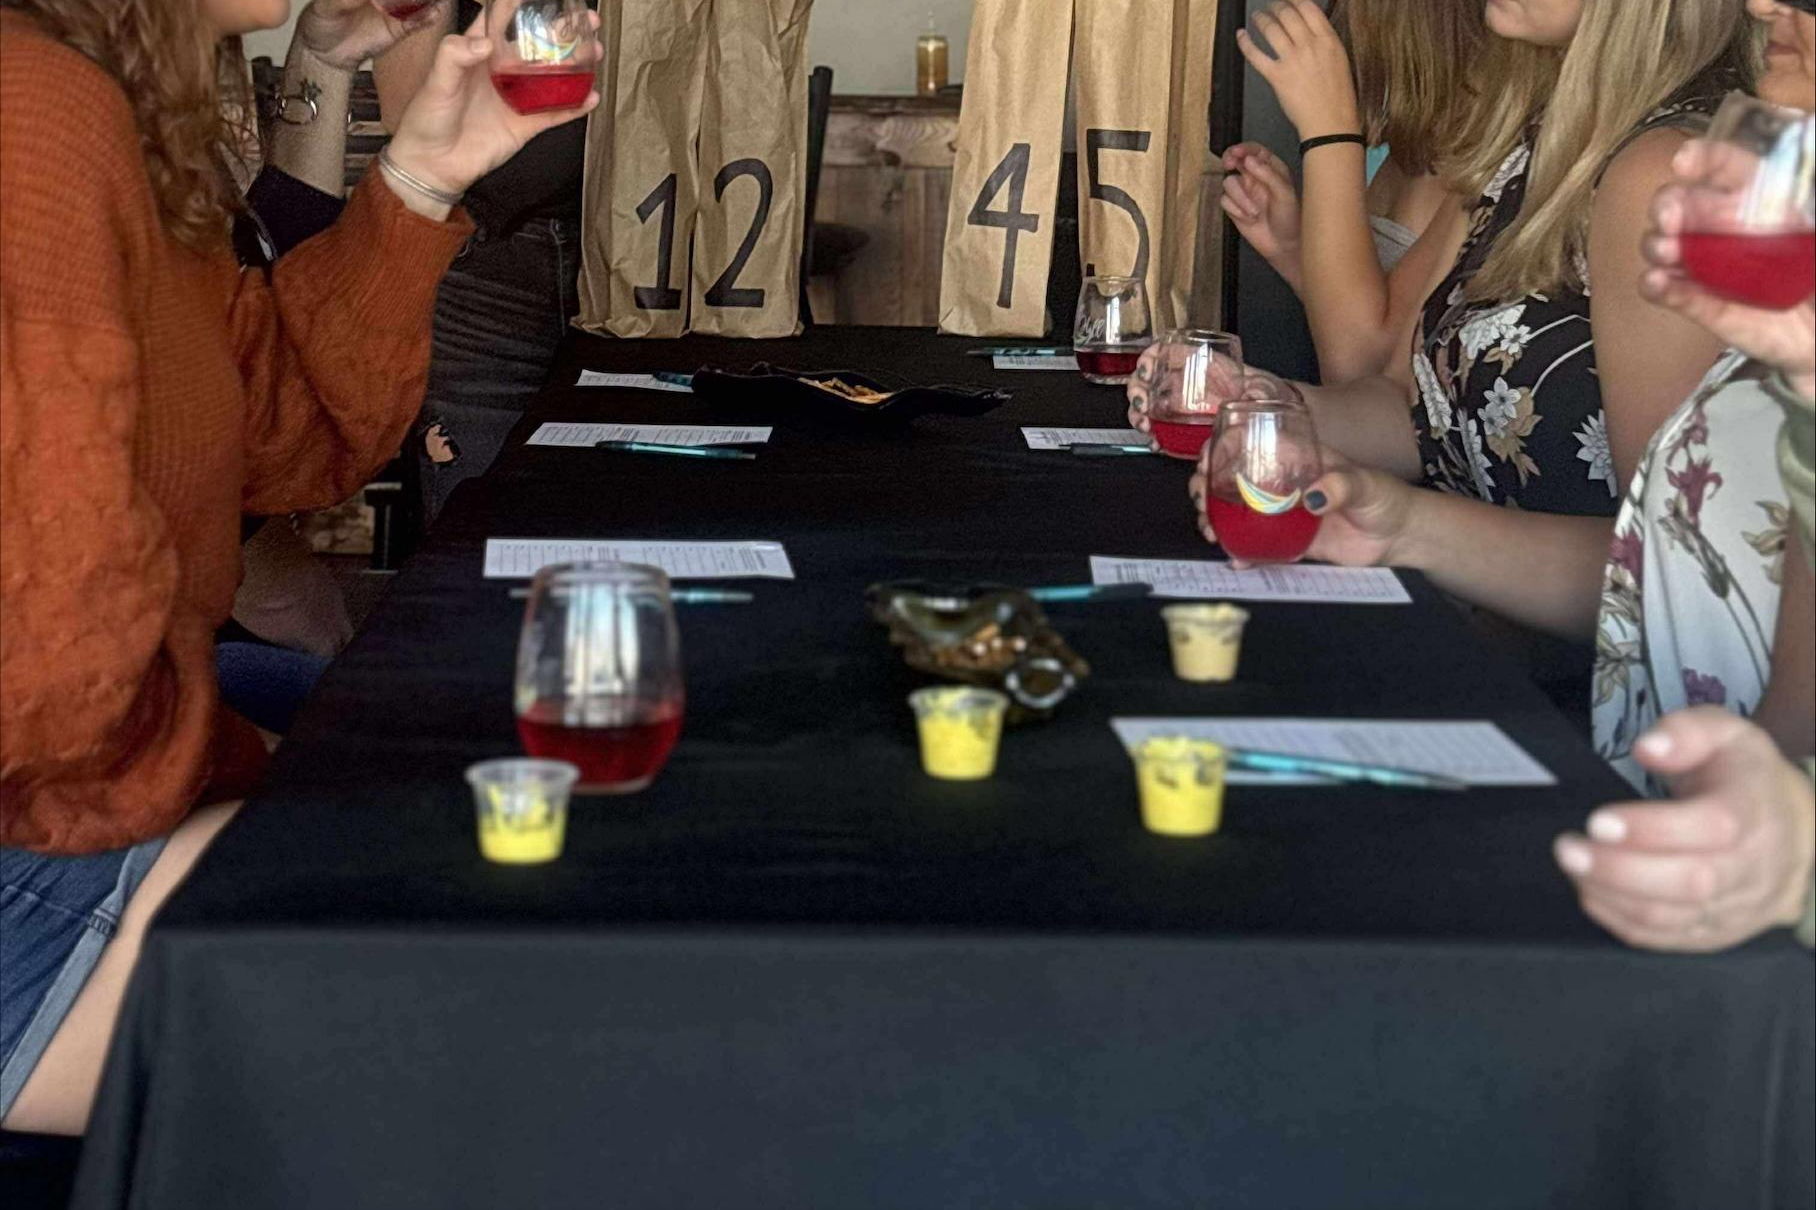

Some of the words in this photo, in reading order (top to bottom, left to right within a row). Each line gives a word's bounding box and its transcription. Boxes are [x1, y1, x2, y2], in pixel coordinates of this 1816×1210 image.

[634, 172, 682, 310] 1
[704, 158, 773, 308] 2
[967, 142, 1040, 309] 4
[1086, 128, 1152, 300] 5
